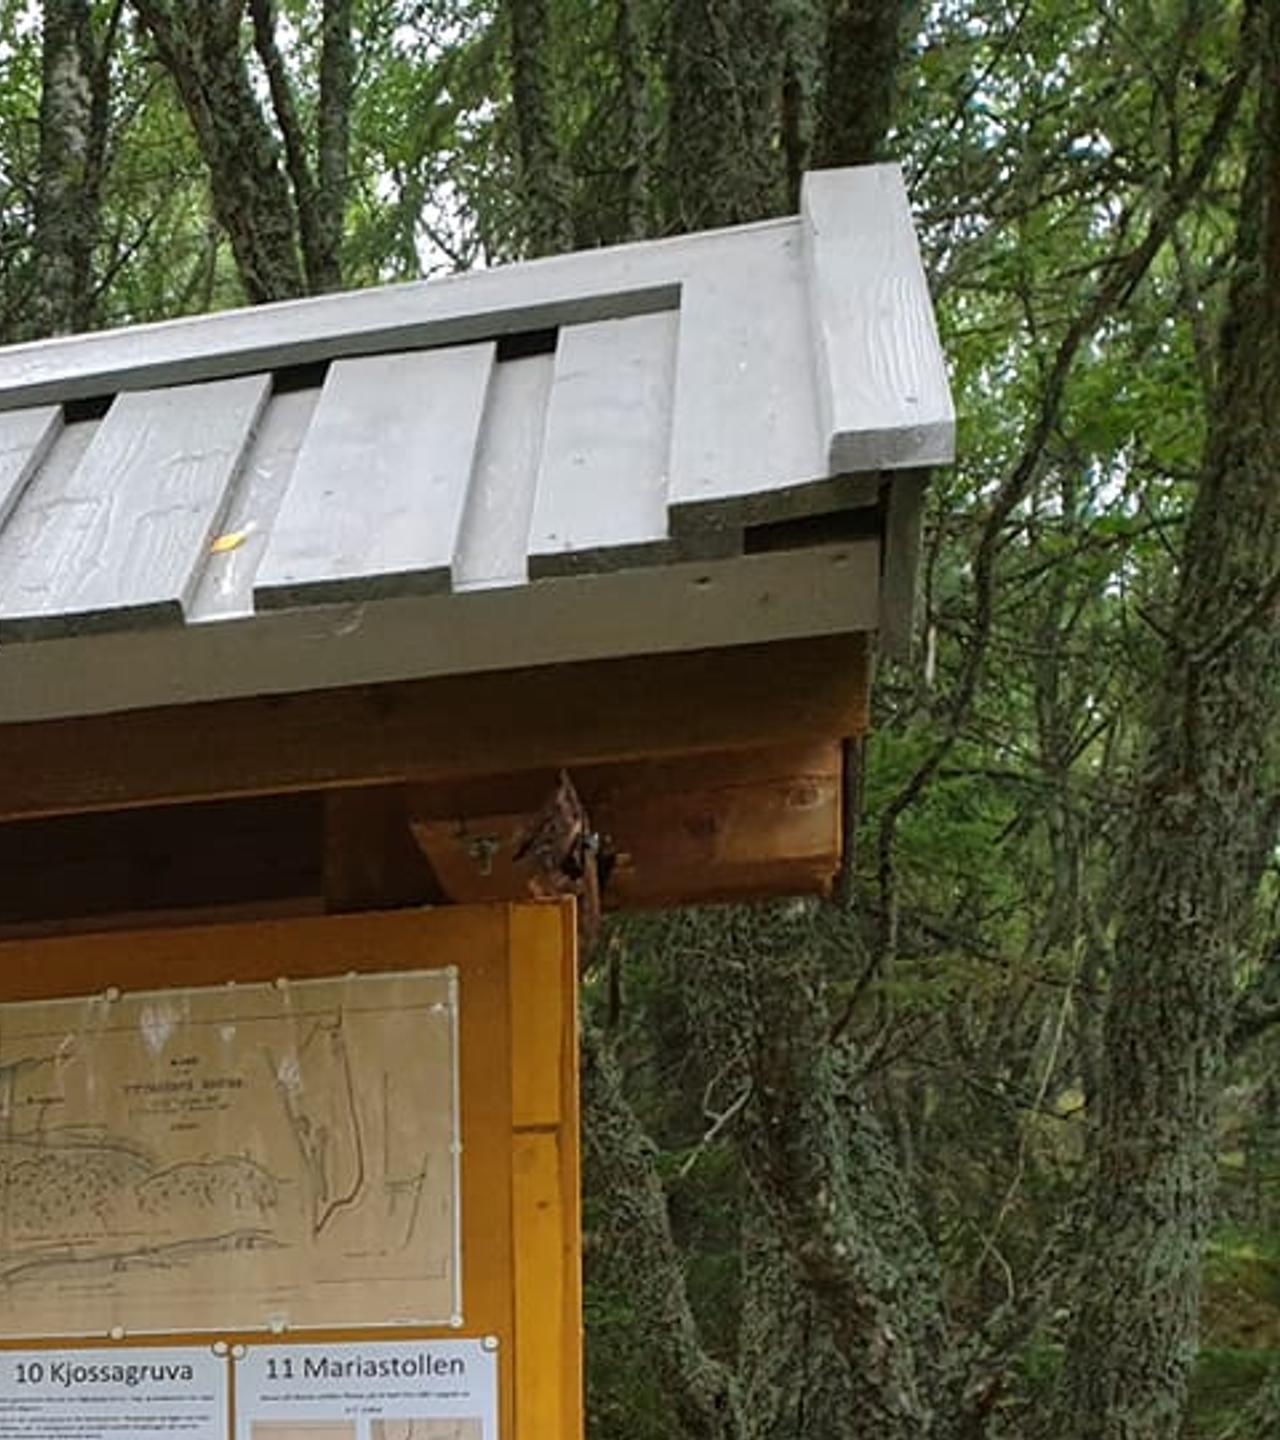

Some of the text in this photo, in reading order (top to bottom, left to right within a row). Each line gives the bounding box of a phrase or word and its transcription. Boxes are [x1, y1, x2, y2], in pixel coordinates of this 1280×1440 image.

[15, 1361, 194, 1387] 10 Kjossagruva
[267, 1353, 464, 1379] 11 Mariastollen
